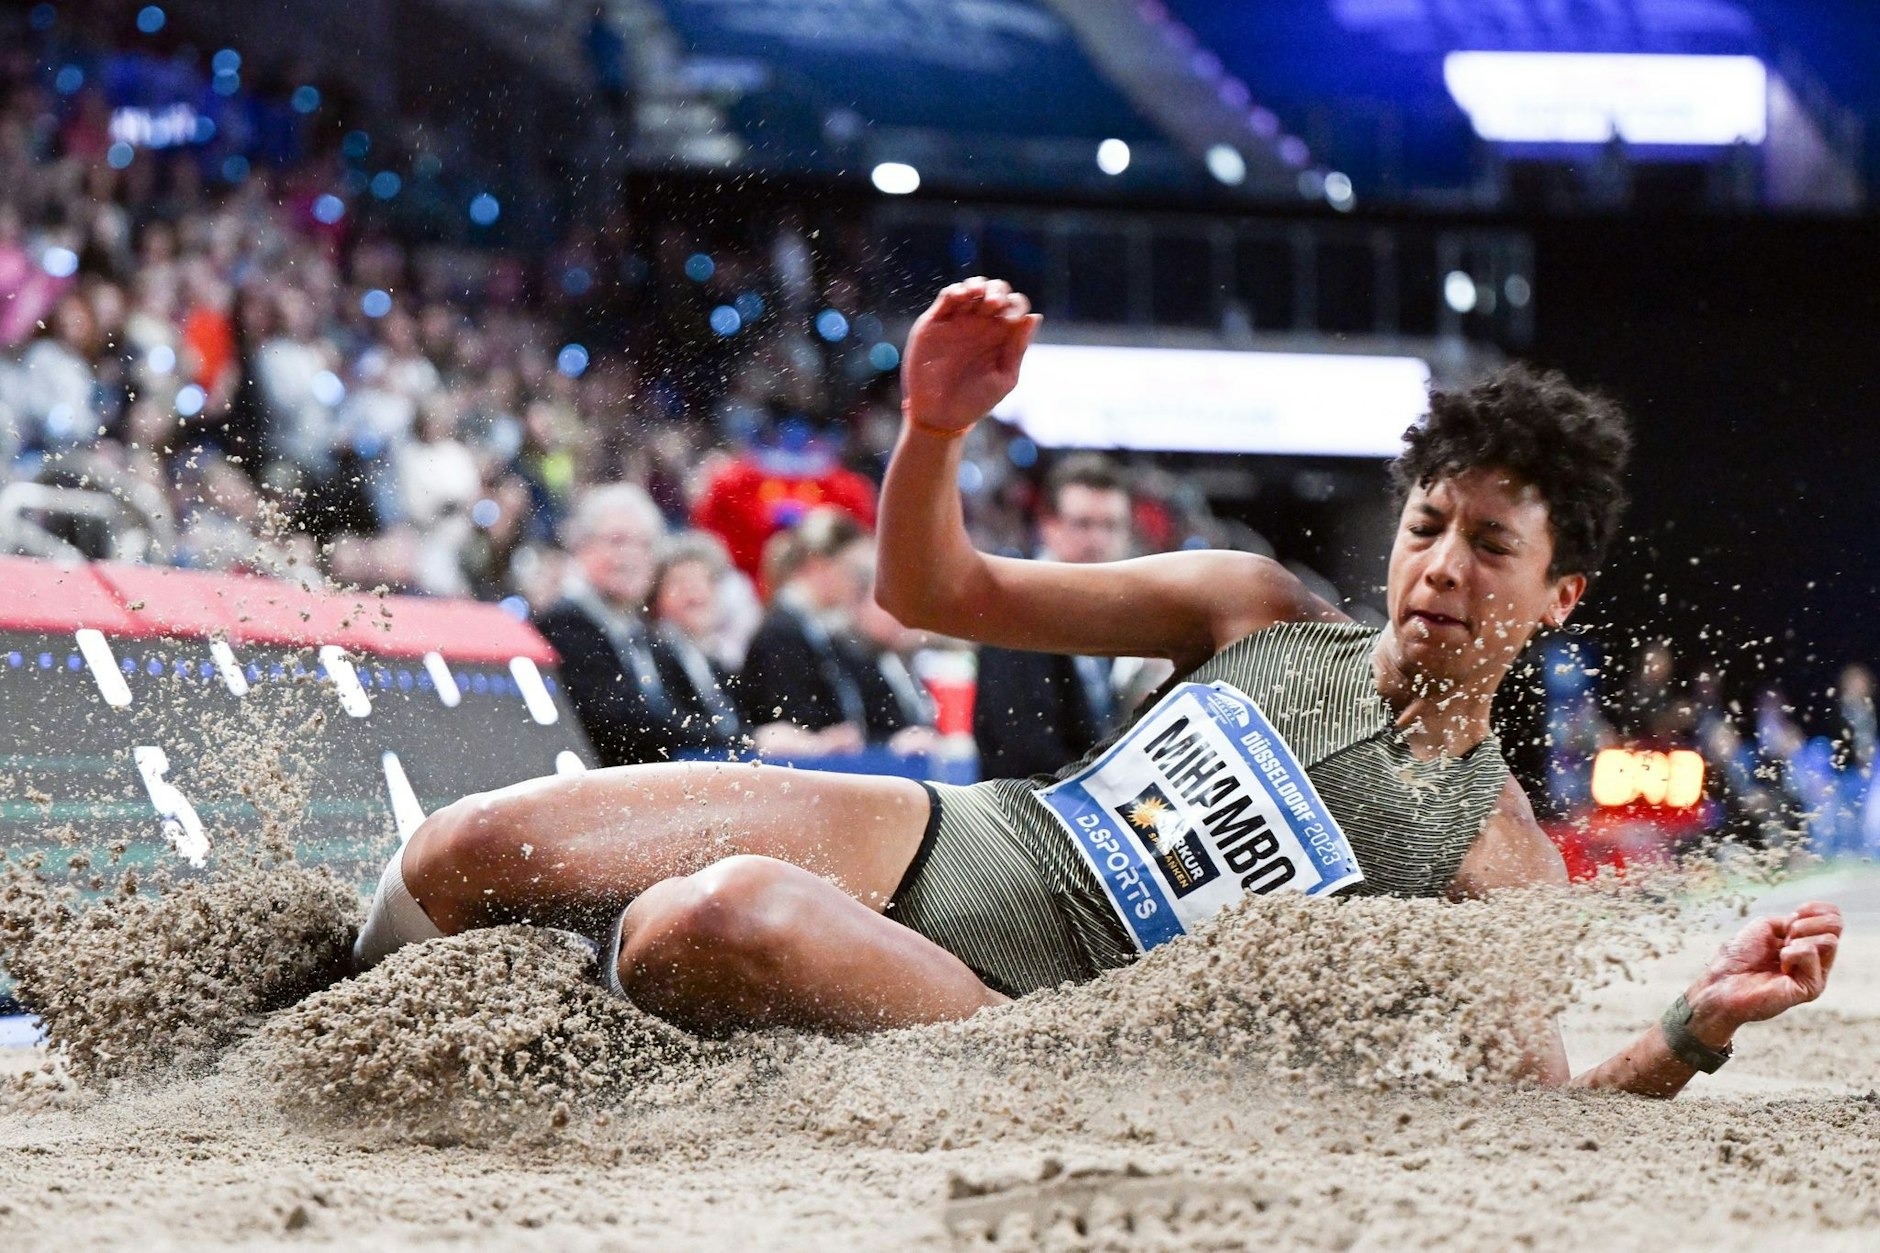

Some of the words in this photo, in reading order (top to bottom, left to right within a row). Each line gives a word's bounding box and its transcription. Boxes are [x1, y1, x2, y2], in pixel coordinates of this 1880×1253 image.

[1143, 714, 1297, 896] MIHAMBO
[1240, 730, 1317, 822] DÜSSELDORF
[1304, 822, 1341, 866] 2023
[1075, 813, 1158, 920] D.SPORTS
